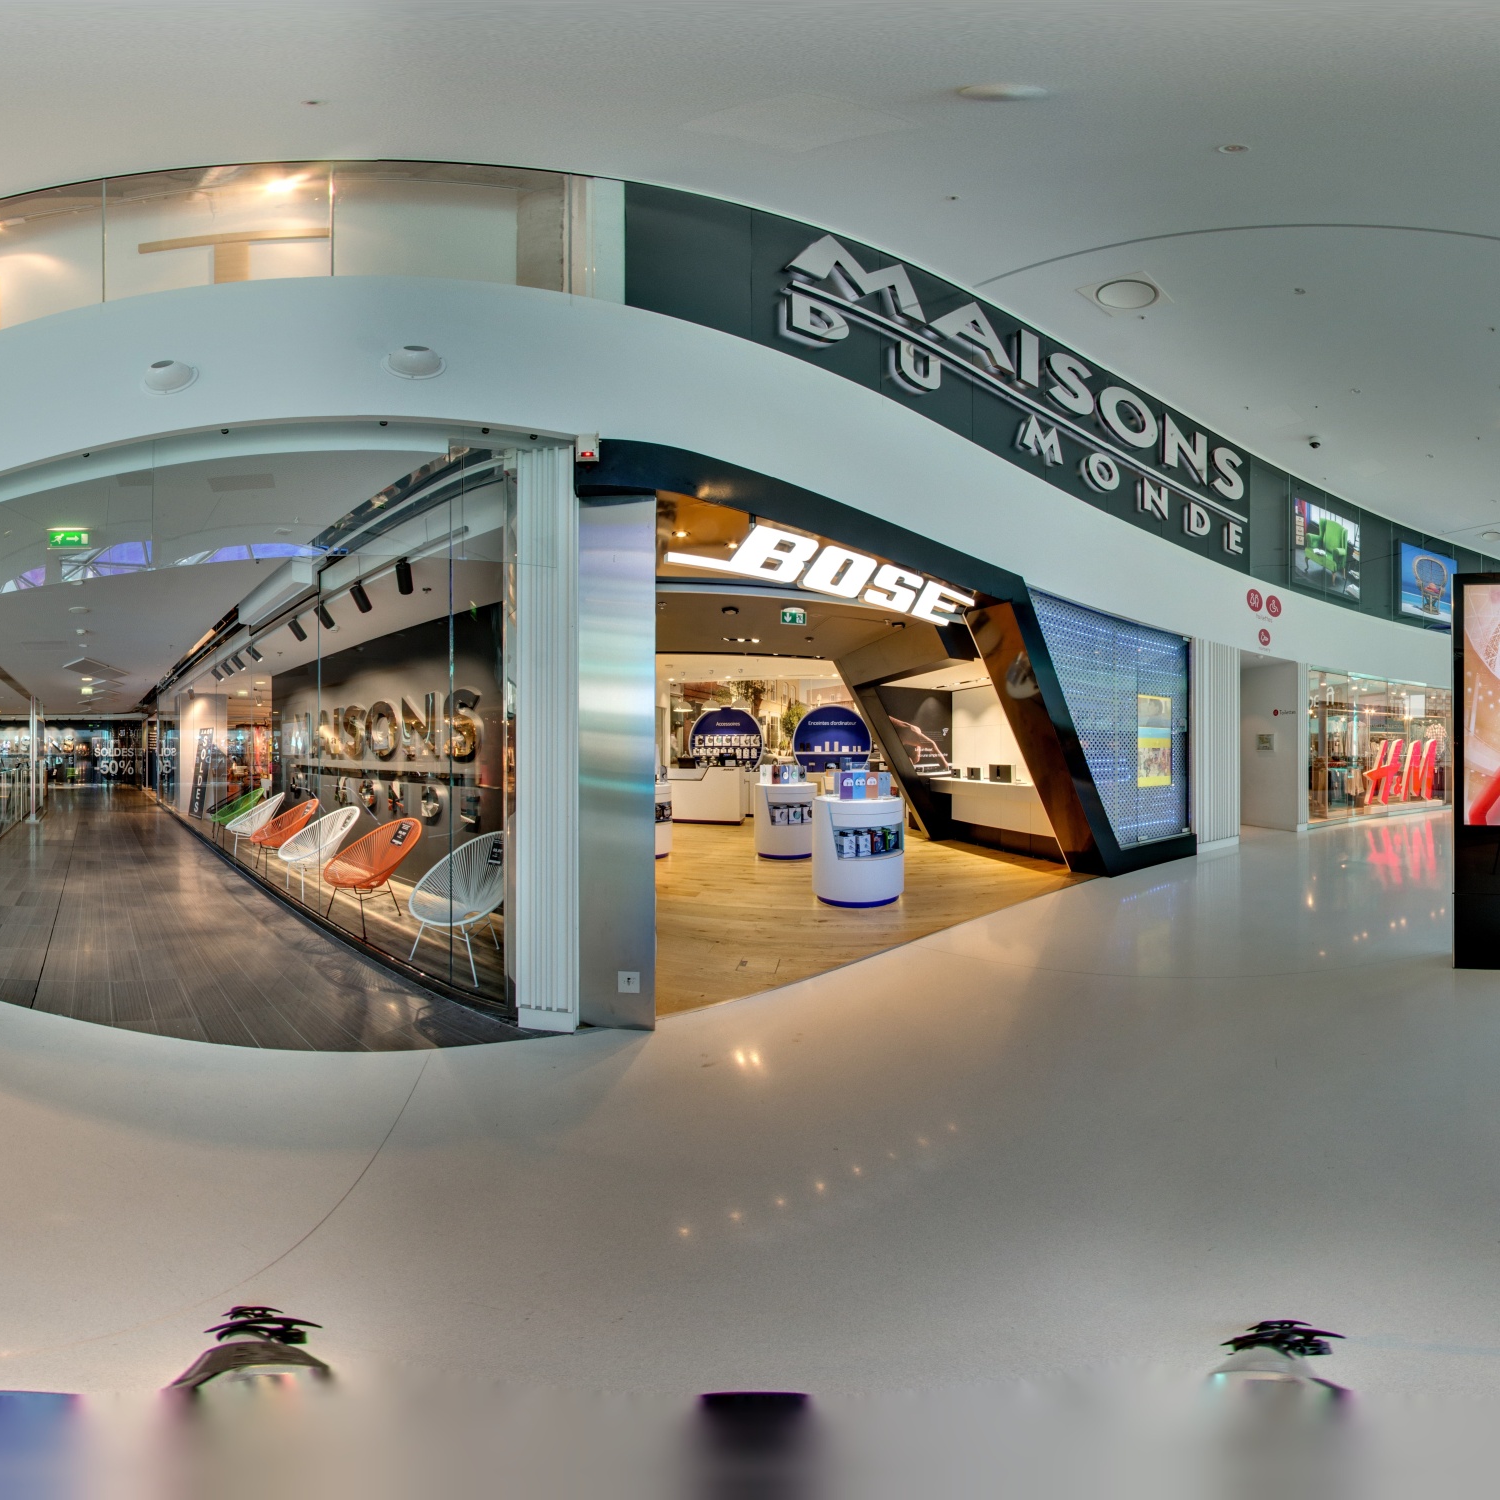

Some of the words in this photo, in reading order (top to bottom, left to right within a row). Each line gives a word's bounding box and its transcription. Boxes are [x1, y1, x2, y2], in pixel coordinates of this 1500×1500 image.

[783, 234, 1244, 500] MAISONS
[783, 292, 941, 392] DU
[1021, 414, 1244, 553] MONDE
[663, 525, 975, 626] BOSE
[94, 747, 135, 757] SOLDES
[293, 688, 485, 764] MAISONS
[94, 760, 135, 775] -50%
[193, 735, 208, 813] SOLDES
[1363, 739, 1437, 805] H&M
